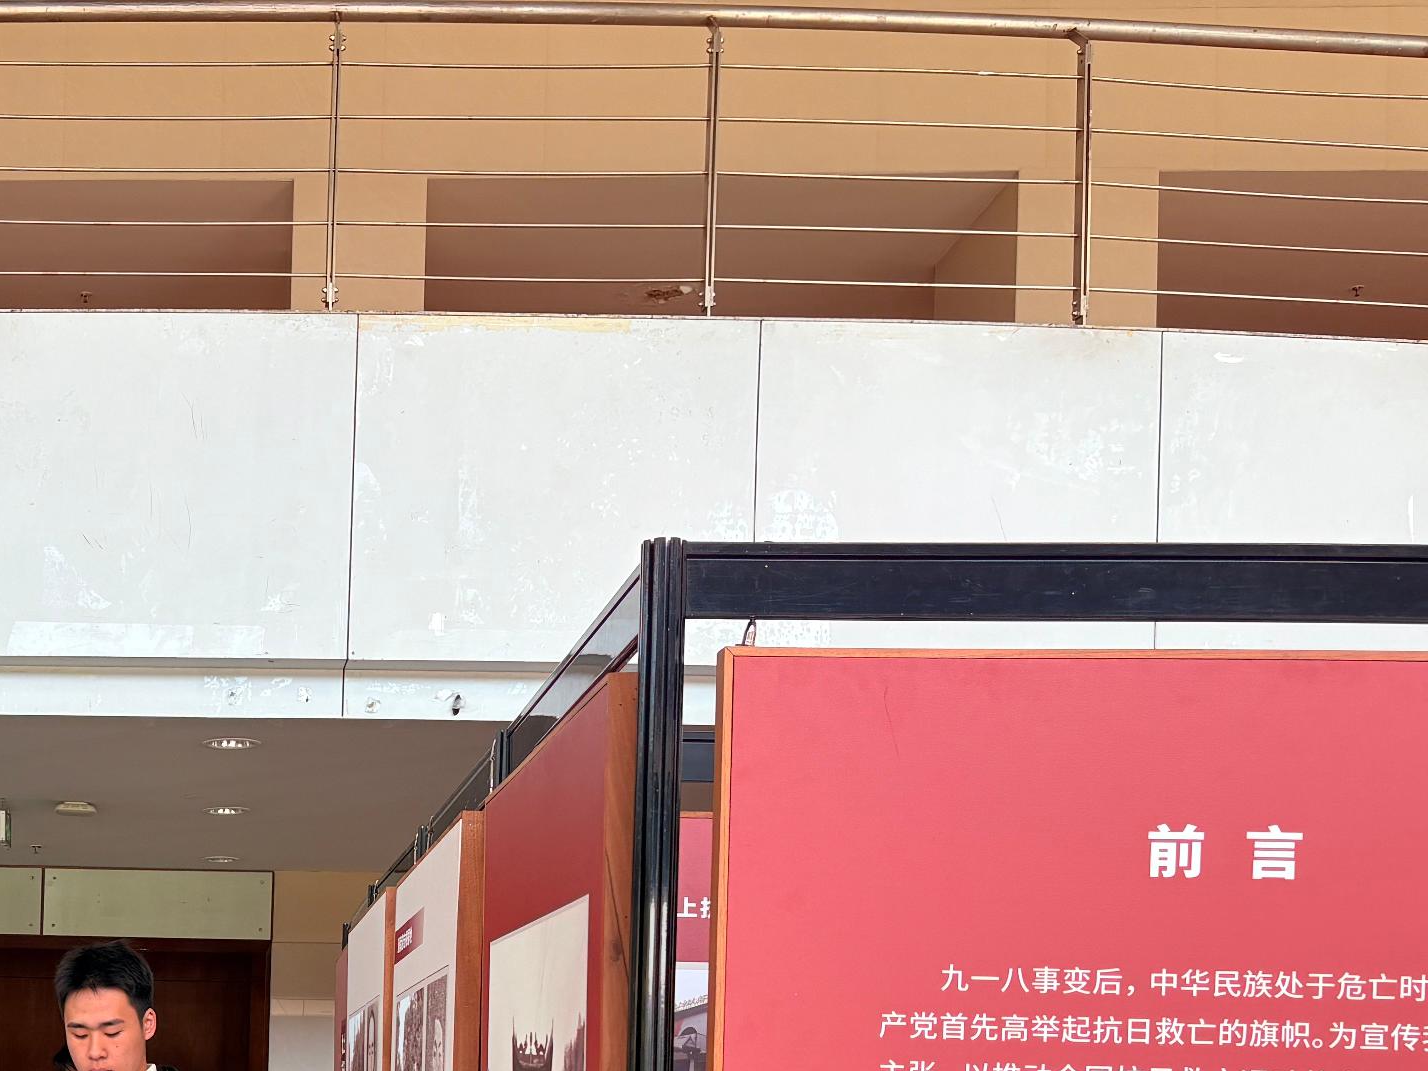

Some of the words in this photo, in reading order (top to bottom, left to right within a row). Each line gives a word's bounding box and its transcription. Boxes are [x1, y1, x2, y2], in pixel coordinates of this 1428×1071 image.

[880, 1011, 1428, 1051] 产党首先高举起抗日救亡的旗帜。为宣传
